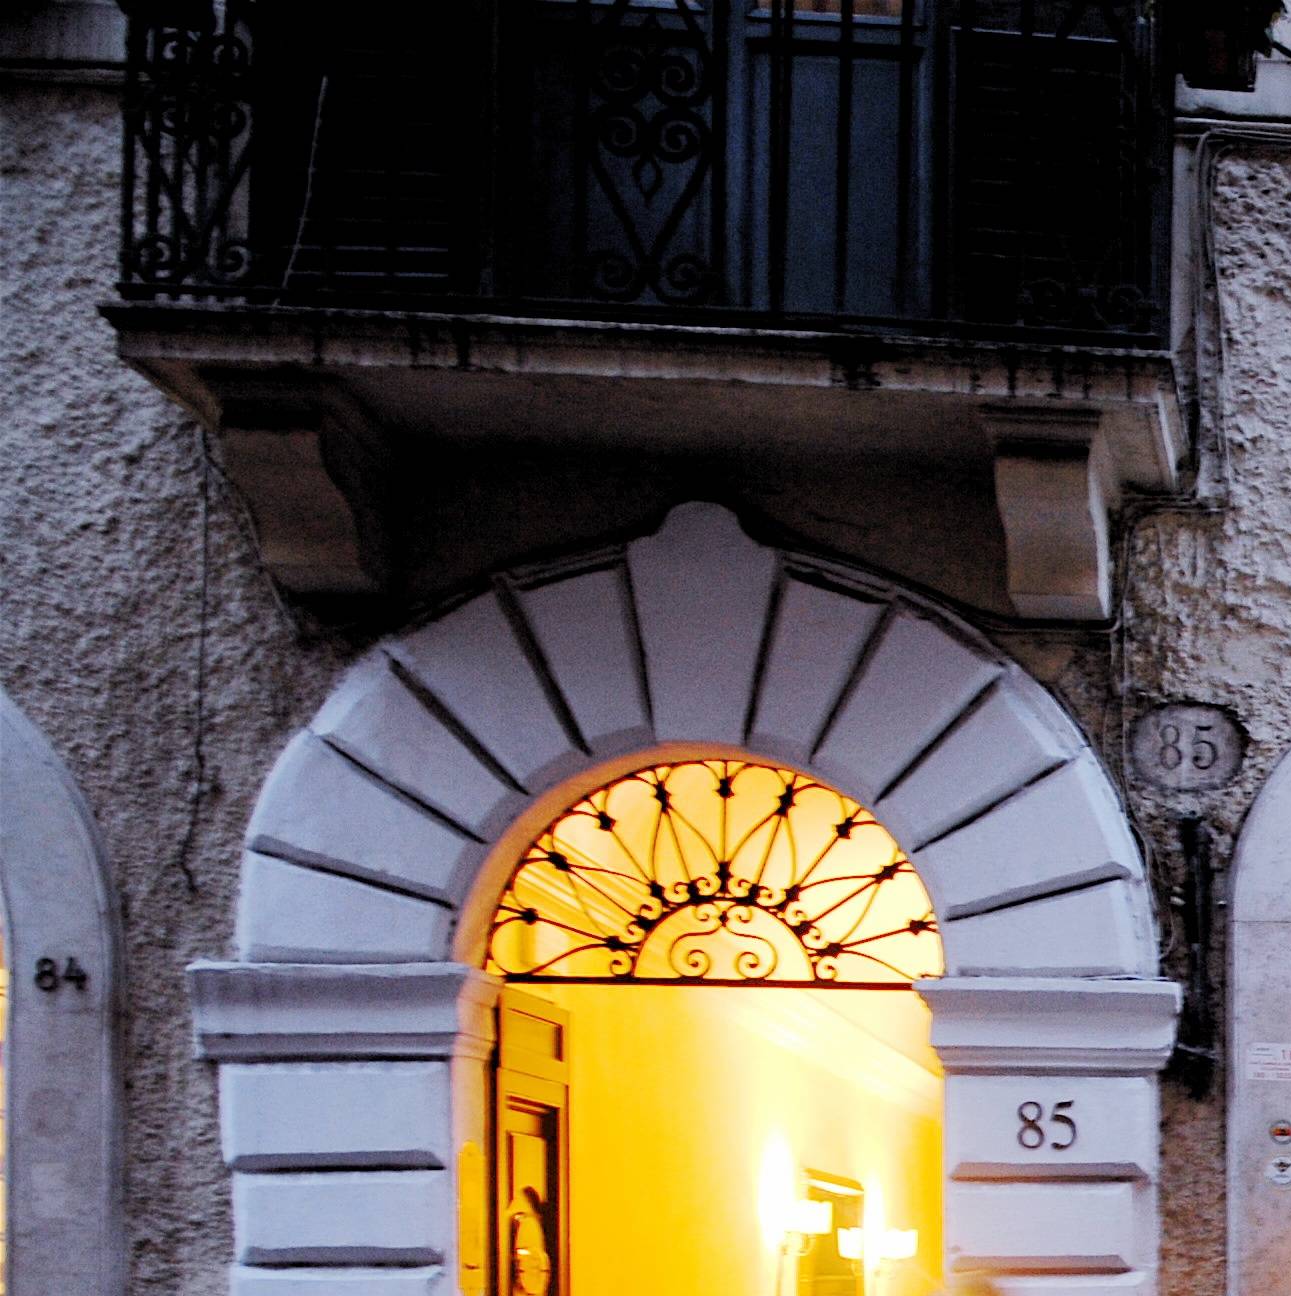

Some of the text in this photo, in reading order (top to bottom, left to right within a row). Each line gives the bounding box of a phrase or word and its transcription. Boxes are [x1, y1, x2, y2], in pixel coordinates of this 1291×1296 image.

[1159, 723, 1218, 771] 85
[34, 957, 87, 992] 84
[1016, 1100, 1077, 1150] 85
